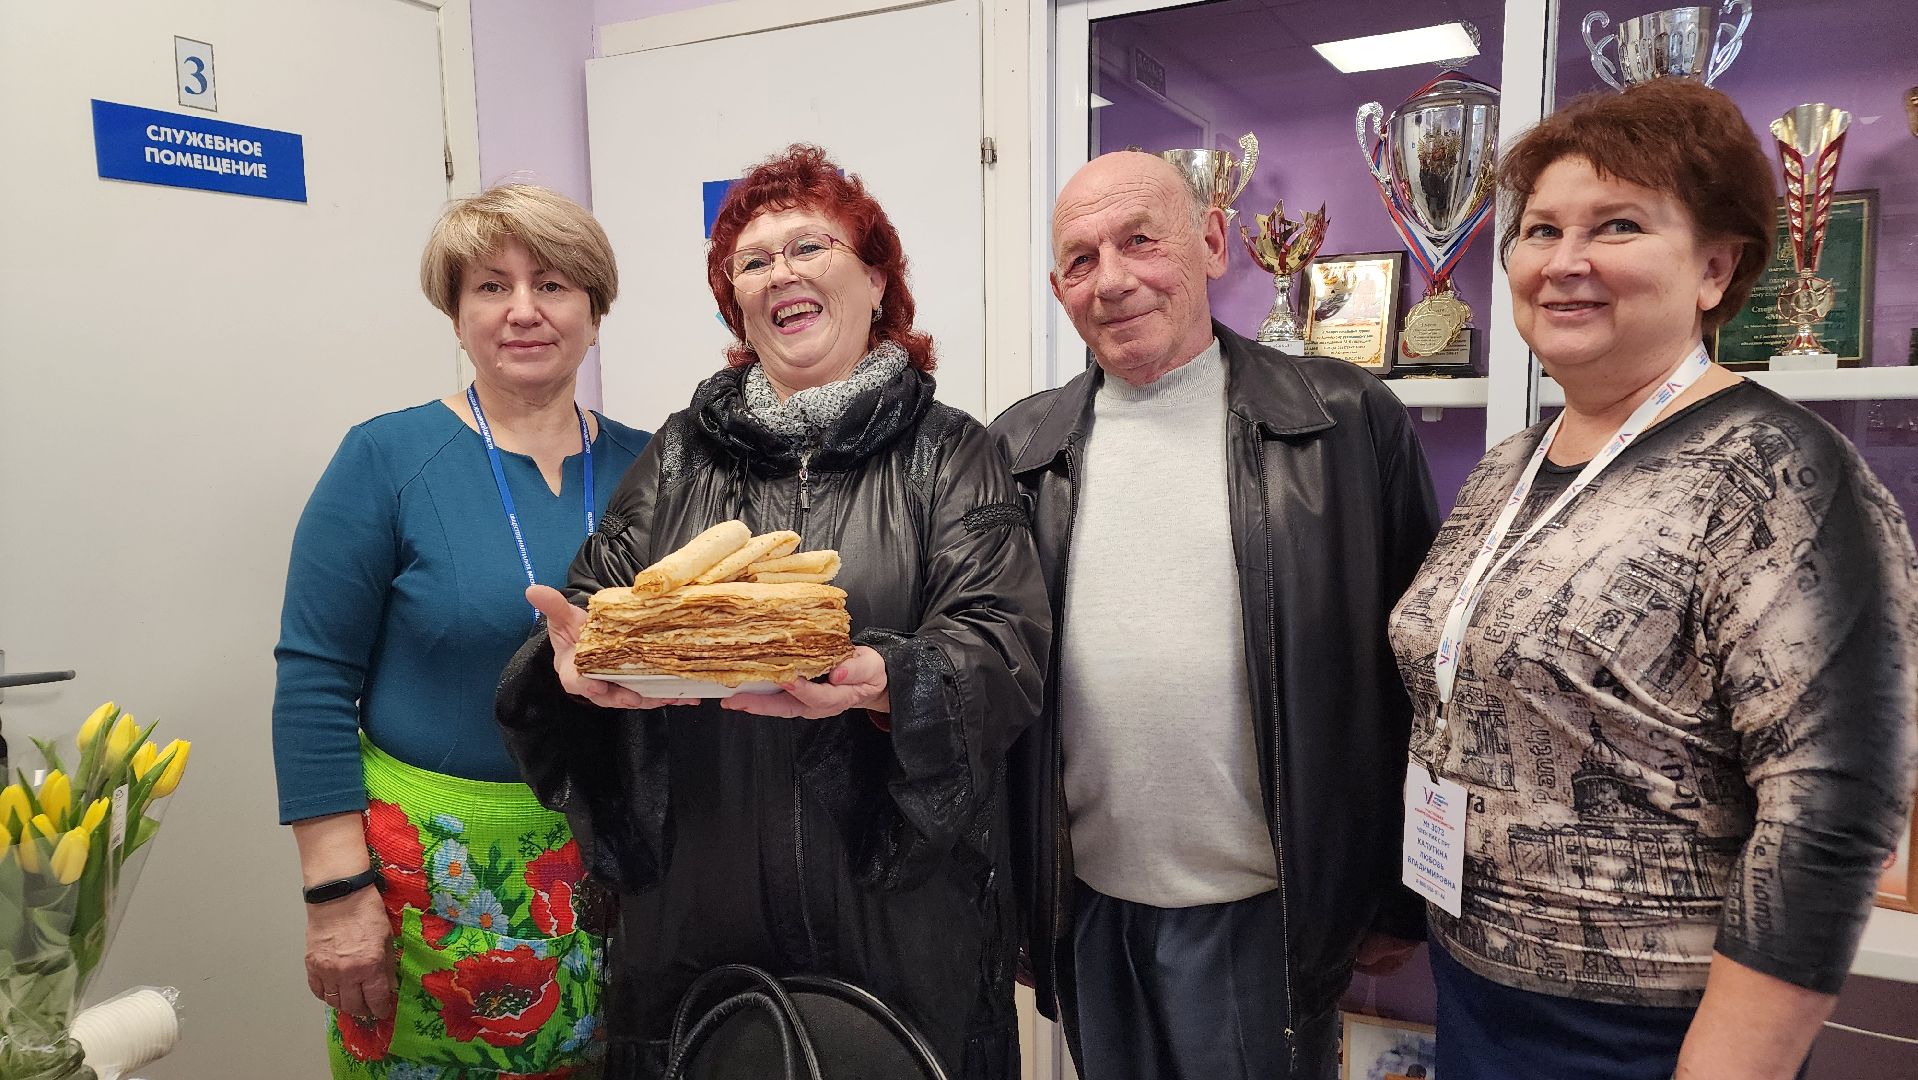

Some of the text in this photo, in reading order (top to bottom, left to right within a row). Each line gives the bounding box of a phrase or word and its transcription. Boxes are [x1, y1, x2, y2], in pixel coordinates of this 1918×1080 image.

[184, 56, 208, 94] 3
[146, 124, 262, 157] СЛУЖЕБНОЕ
[144, 146, 268, 178] ПОМЕЩЕНИЕ
[1417, 837, 1447, 860] КАЛУГИНА
[1419, 850, 1444, 871] ЛЮБОВЬ
[1407, 854, 1455, 890] ВЛАДИМИРОВНА
